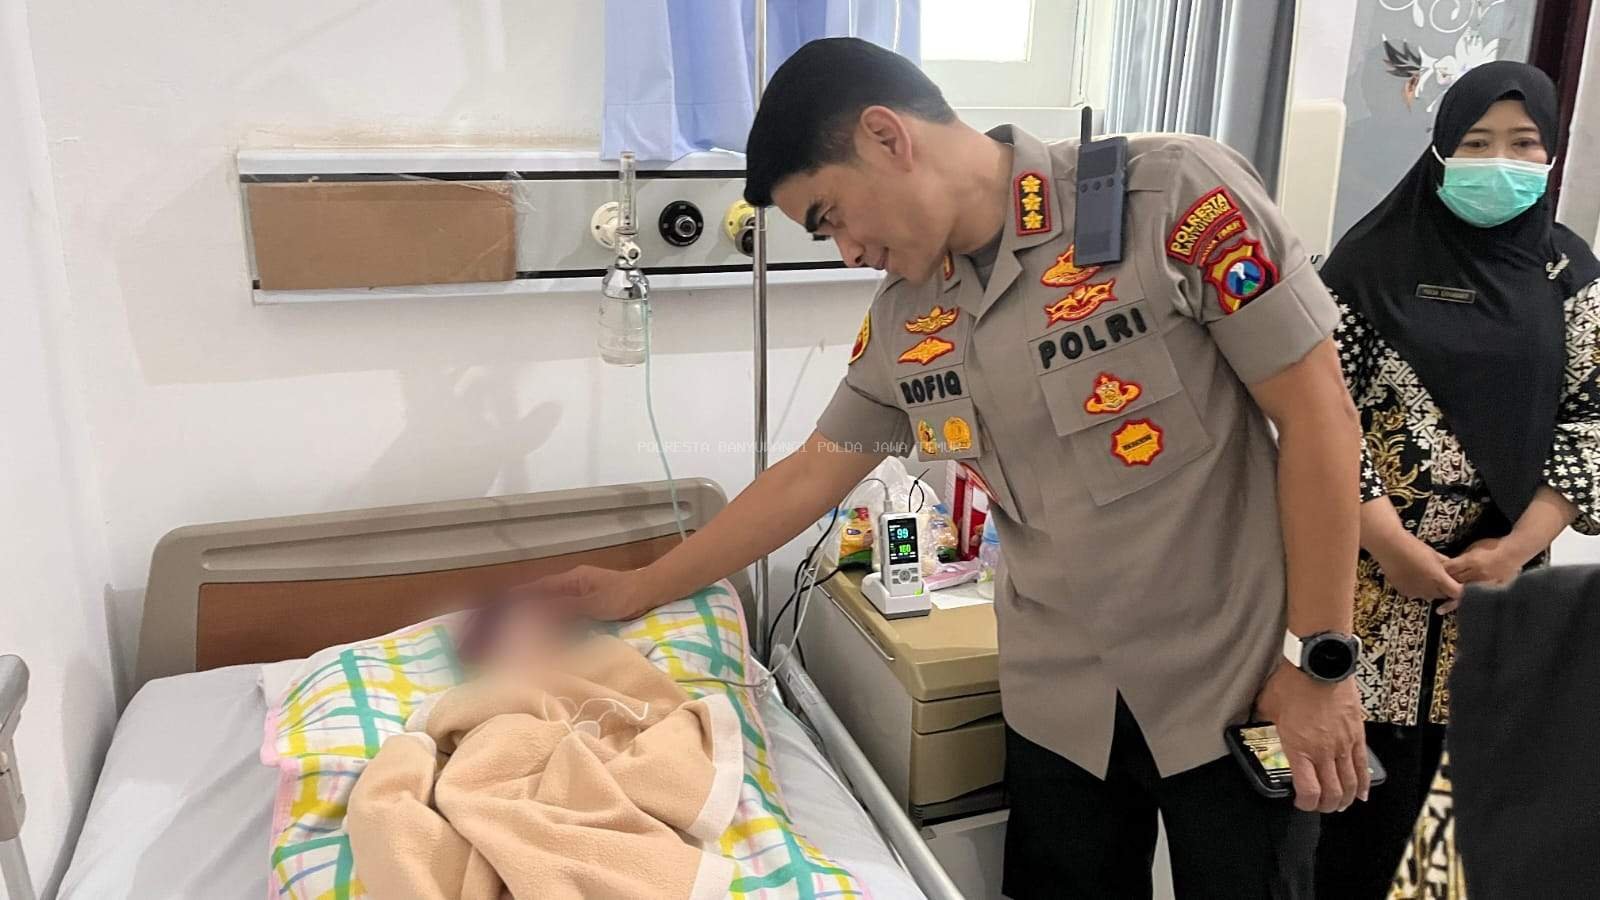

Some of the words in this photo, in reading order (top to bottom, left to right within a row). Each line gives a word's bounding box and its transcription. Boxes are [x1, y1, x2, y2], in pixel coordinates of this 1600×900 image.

[1170, 193, 1229, 252] POLRESTA
[1038, 307, 1147, 369] POLRI
[900, 370, 962, 404] ROFIQ
